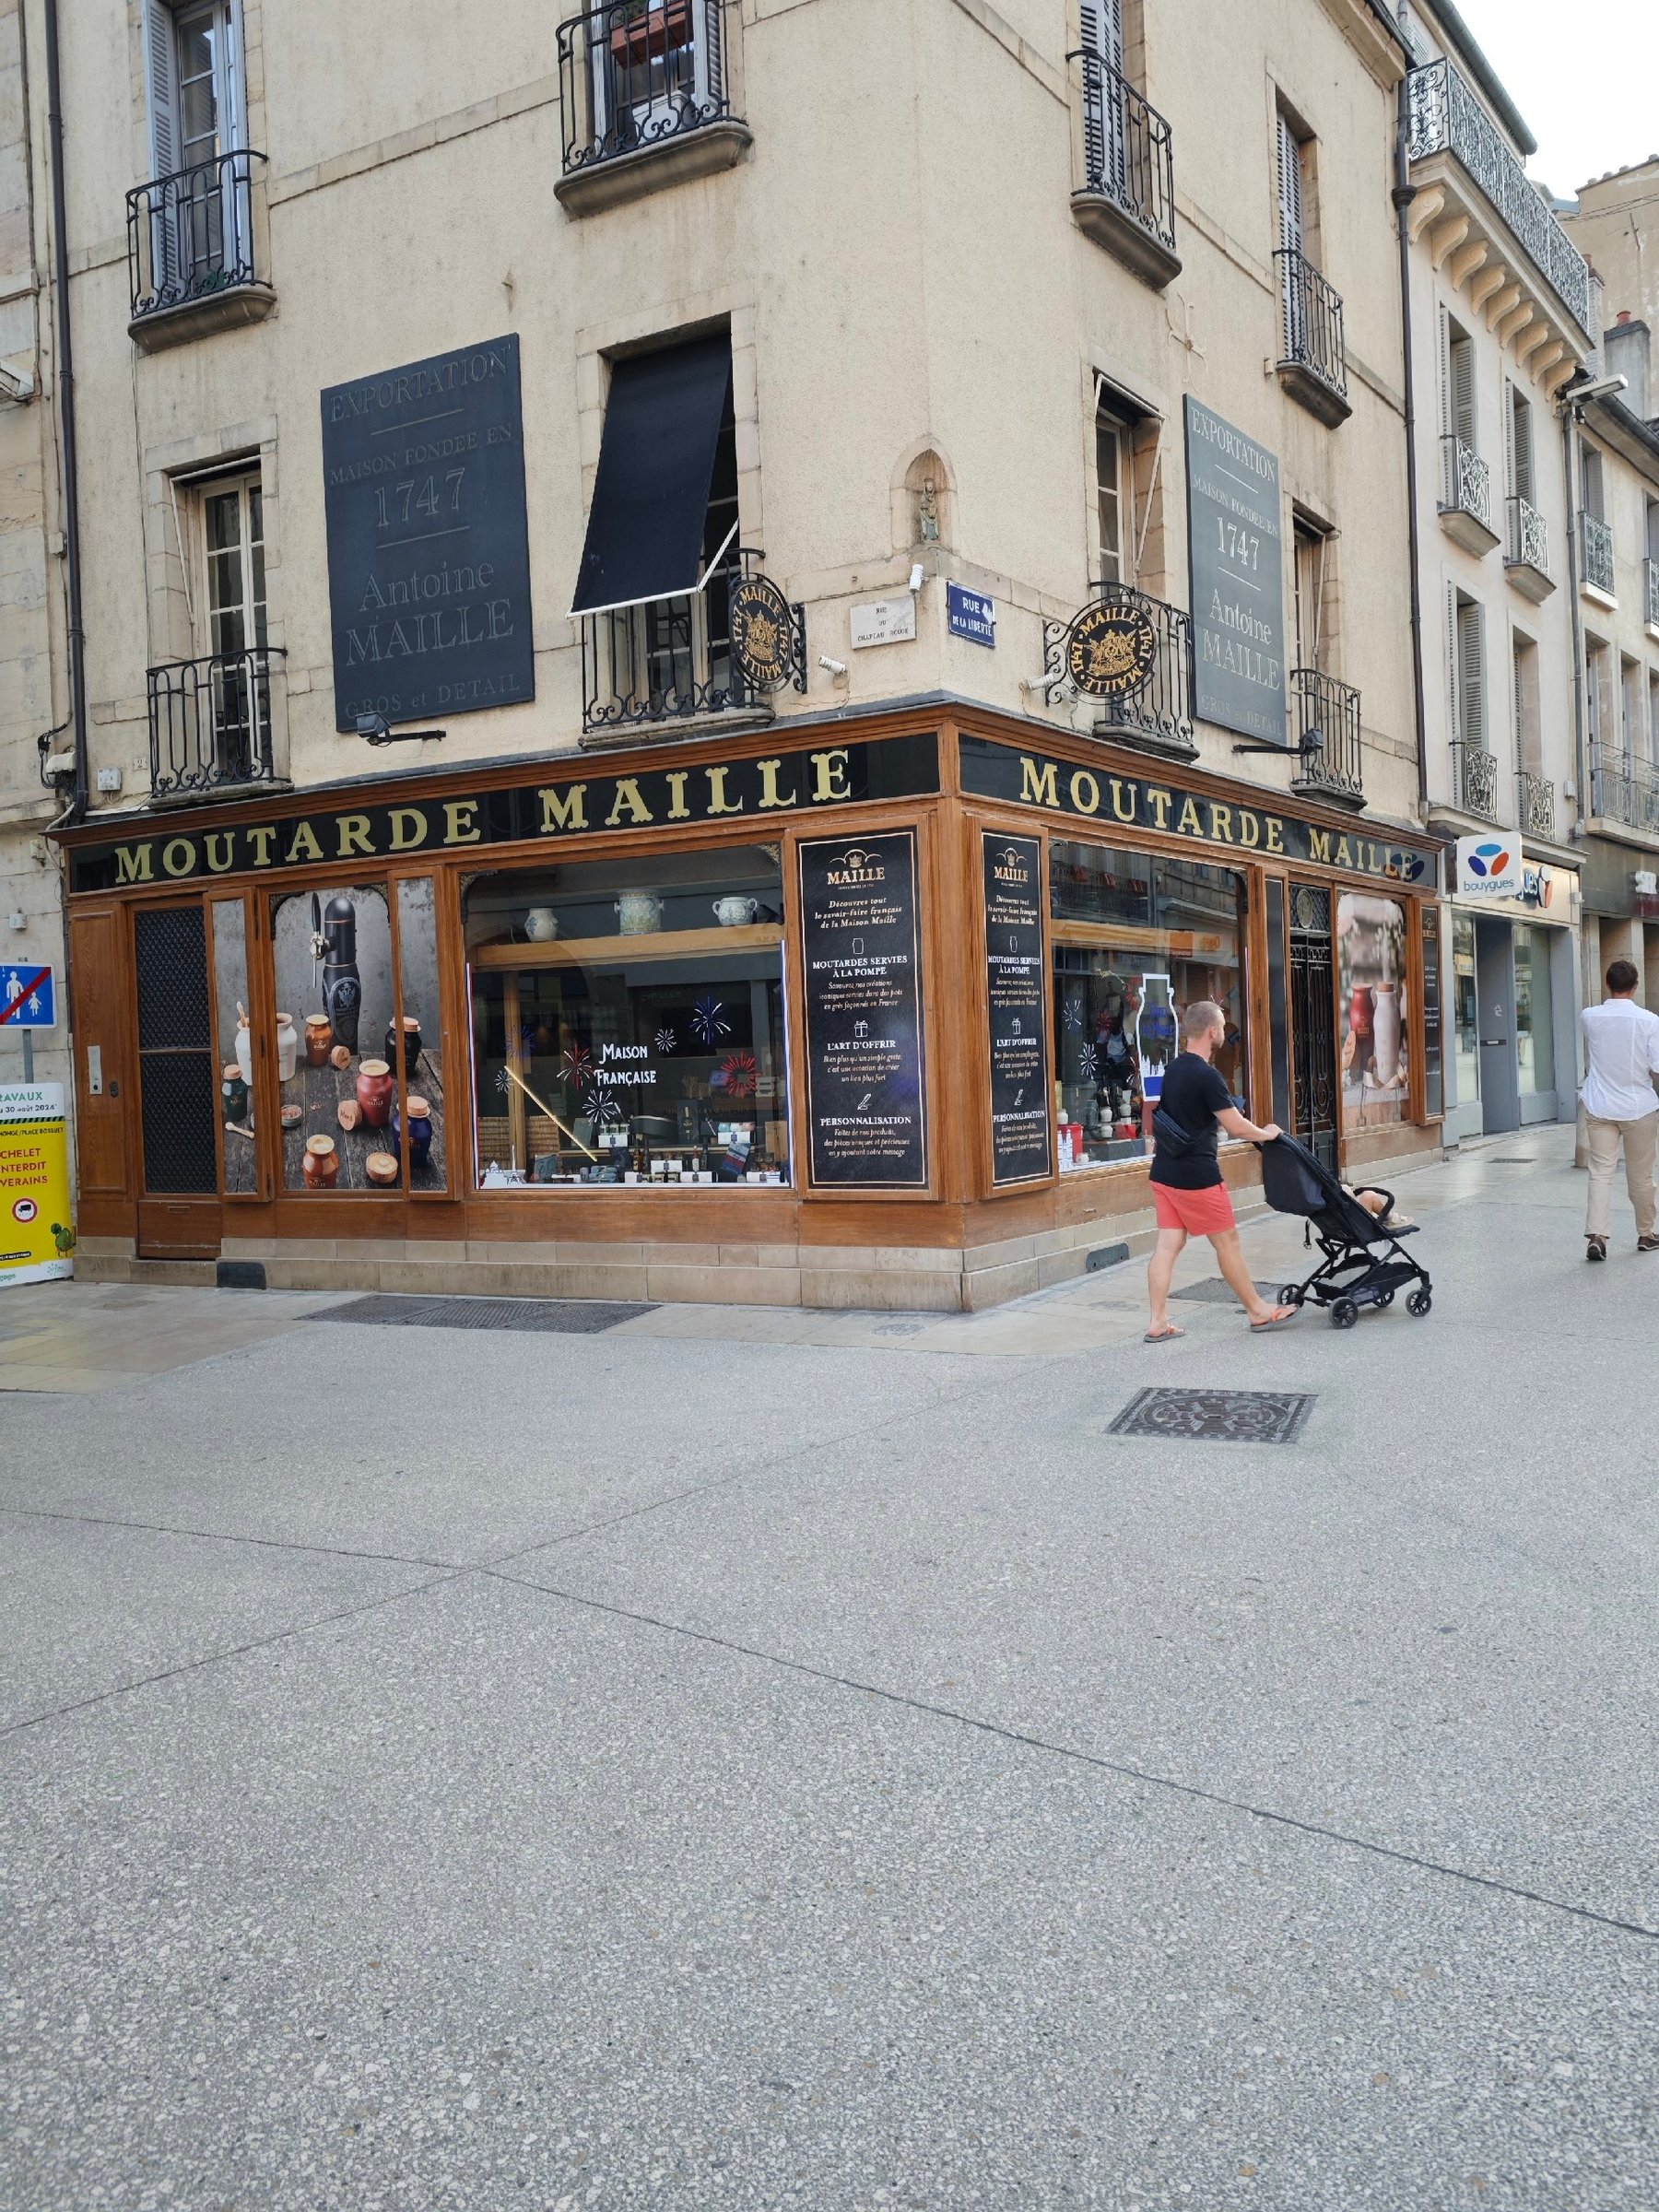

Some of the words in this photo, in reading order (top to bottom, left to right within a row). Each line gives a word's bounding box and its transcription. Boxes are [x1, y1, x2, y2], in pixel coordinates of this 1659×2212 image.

[330, 346, 508, 423] EXPORTATION
[330, 452, 397, 486] MAISON
[487, 422, 513, 444] EN
[1191, 406, 1277, 484] EXPORTATION
[374, 467, 466, 529] 1747
[1193, 474, 1229, 508] MAISON
[1265, 521, 1278, 537] EN
[1217, 516, 1260, 571] 1747
[359, 561, 495, 612] Antoine
[740, 586, 782, 618] MAILLE
[962, 596, 981, 614] RUE
[346, 597, 514, 667] MAILLE
[952, 615, 959, 626] DE
[959, 617, 966, 629] LA
[1079, 606, 1140, 636] MAILLE
[1209, 587, 1272, 646] Antoine
[741, 651, 782, 679] MAILLE
[1083, 665, 1144, 693] MAILLE
[1202, 629, 1280, 691] MAILLE
[345, 693, 402, 720] GROS
[411, 692, 428, 709] et
[437, 674, 522, 704] DETAIL
[1201, 693, 1231, 717] GROS
[1246, 710, 1283, 737] DETAIL
[537, 749, 853, 833] MAILLE
[1019, 756, 1285, 853] MOUTARDE
[114, 800, 482, 884] MOUTARDE
[1309, 828, 1415, 881] MAILLE
[827, 866, 885, 885] MAILLE
[994, 865, 1029, 882] MAILLE
[1464, 878, 1514, 893] bouygues
[815, 912, 822, 920] le
[870, 905, 902, 915] français
[820, 921, 829, 929] de
[831, 920, 839, 928] la
[841, 919, 869, 927] Maison
[871, 915, 897, 924] Maille
[828, 900, 868, 909] Découvrez
[813, 958, 868, 970] MOUTARDES
[870, 955, 908, 965] SERVIES
[832, 968, 840, 978] À
[854, 967, 888, 976] POMPE
[827, 1041, 851, 1051] L'ART
[852, 1040, 897, 1050] D'OFFRIR
[819, 1116, 912, 1126] PERSONNALISATION
